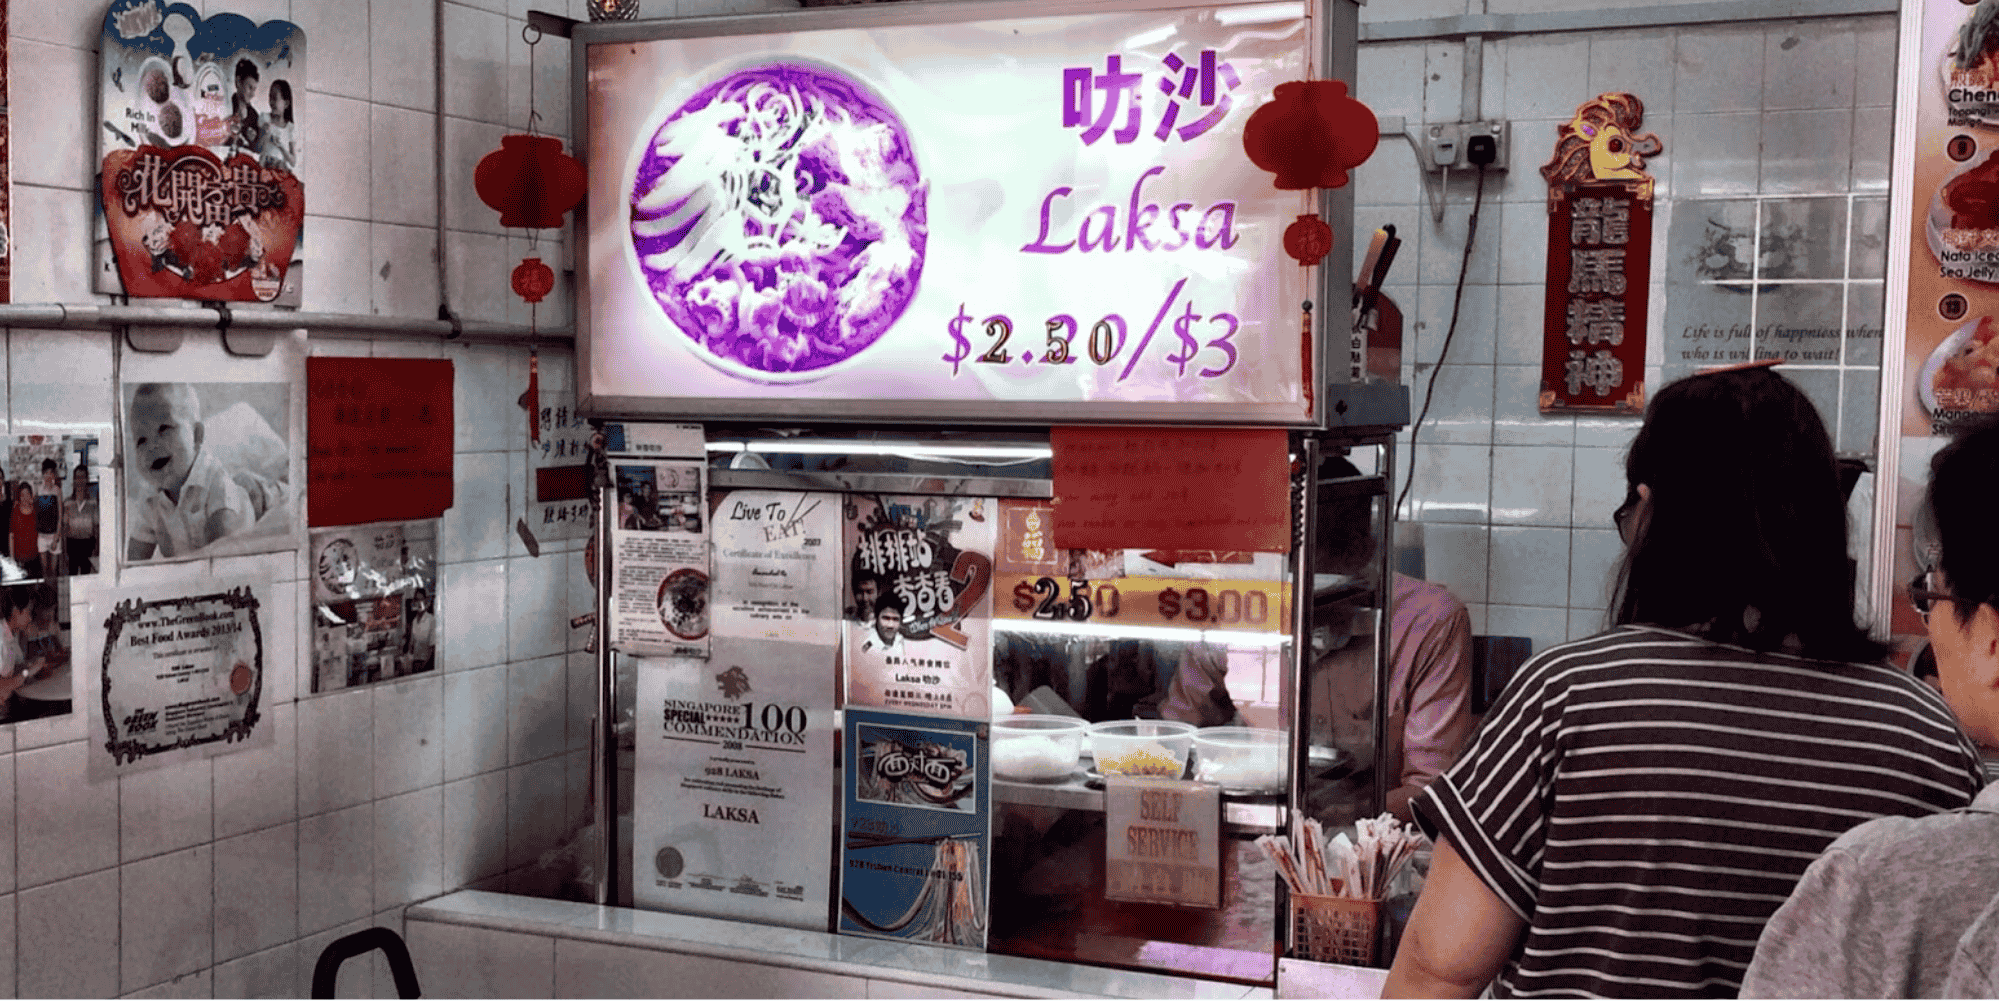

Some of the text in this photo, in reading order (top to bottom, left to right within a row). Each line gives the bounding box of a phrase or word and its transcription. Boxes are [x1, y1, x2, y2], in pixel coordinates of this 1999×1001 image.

[1062, 49, 1242, 147] 叻沙
[1949, 88, 1999, 104] Chen
[125, 108, 155, 122] Rich In
[1019, 165, 1241, 255] Laksa
[1940, 250, 1971, 262] Nata
[1939, 266, 1996, 280] Sea Jelly
[1564, 196, 1630, 397] 龍馬精神
[1681, 324, 1710, 342] Life
[1714, 326, 1724, 339] is
[1725, 324, 1752, 342] full
[1755, 324, 1771, 342] of
[1845, 324, 1884, 339] when
[1681, 346, 1709, 360] who
[1713, 347, 1724, 360] is
[1784, 346, 1798, 360] to
[730, 500, 786, 521] Live To
[930, 550, 992, 652] 2
[1012, 576, 1269, 625] $2.50 $3.00
[138, 610, 235, 630] www.TheGreenBook.com
[130, 621, 242, 647] Best Food Awards 2013/14
[895, 673, 921, 684] Laksa
[664, 699, 741, 716] SINGAPORE
[664, 709, 706, 724] SPECIAL
[741, 702, 808, 739] 100
[663, 721, 807, 745] COMMENDATION
[704, 766, 760, 781] 928 LAKSA
[702, 803, 760, 825] LAKSA
[1140, 788, 1184, 823] SELF
[1126, 825, 1200, 860] SERVICE
